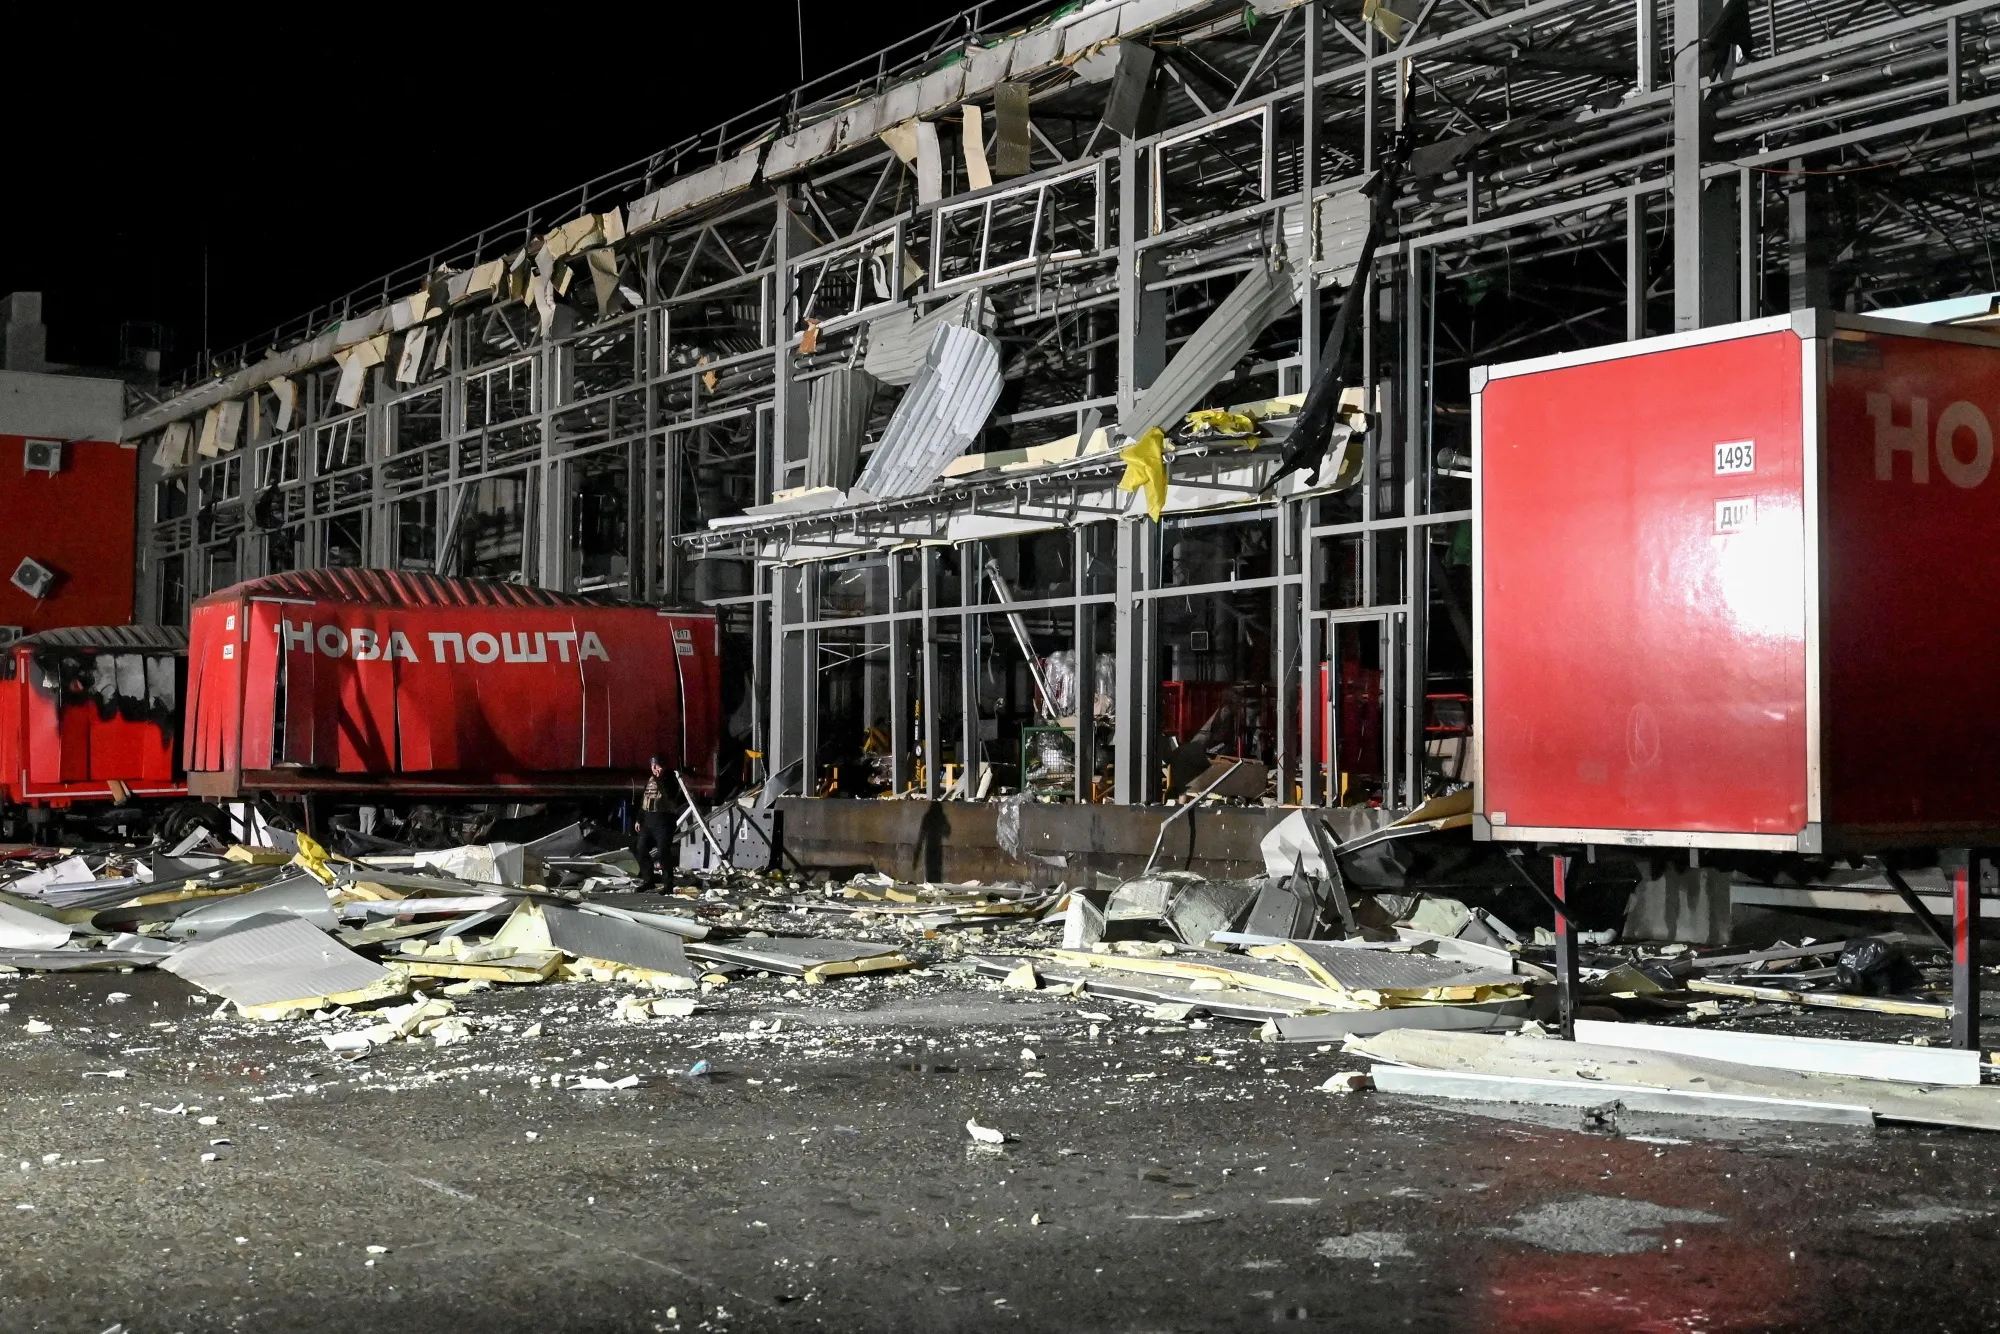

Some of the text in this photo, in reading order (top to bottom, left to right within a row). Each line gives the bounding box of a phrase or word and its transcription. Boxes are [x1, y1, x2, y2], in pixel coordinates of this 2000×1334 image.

[1717, 445, 1752, 470] 1493
[1866, 391, 1994, 489] НО
[274, 620, 610, 663] НОВА ПОШТА
